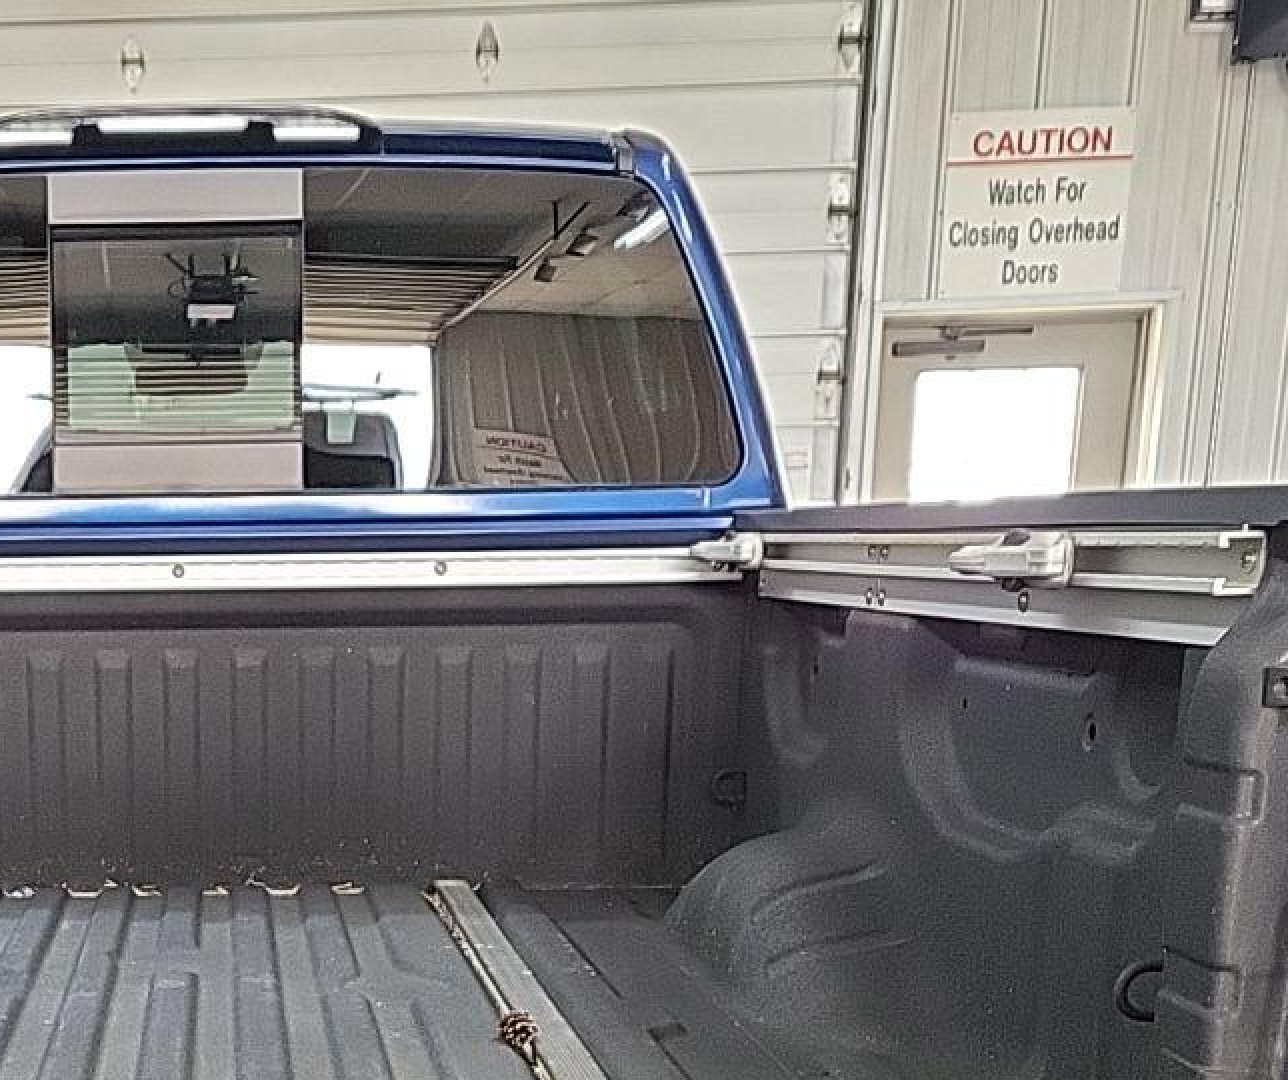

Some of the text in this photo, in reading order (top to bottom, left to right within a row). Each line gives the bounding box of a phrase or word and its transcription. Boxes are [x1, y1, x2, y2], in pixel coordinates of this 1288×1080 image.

[972, 126, 1113, 157] CAUTION
[989, 175, 1088, 206] Watch For
[949, 213, 1121, 250] Closing Overhead
[1001, 259, 1059, 285] Doors
